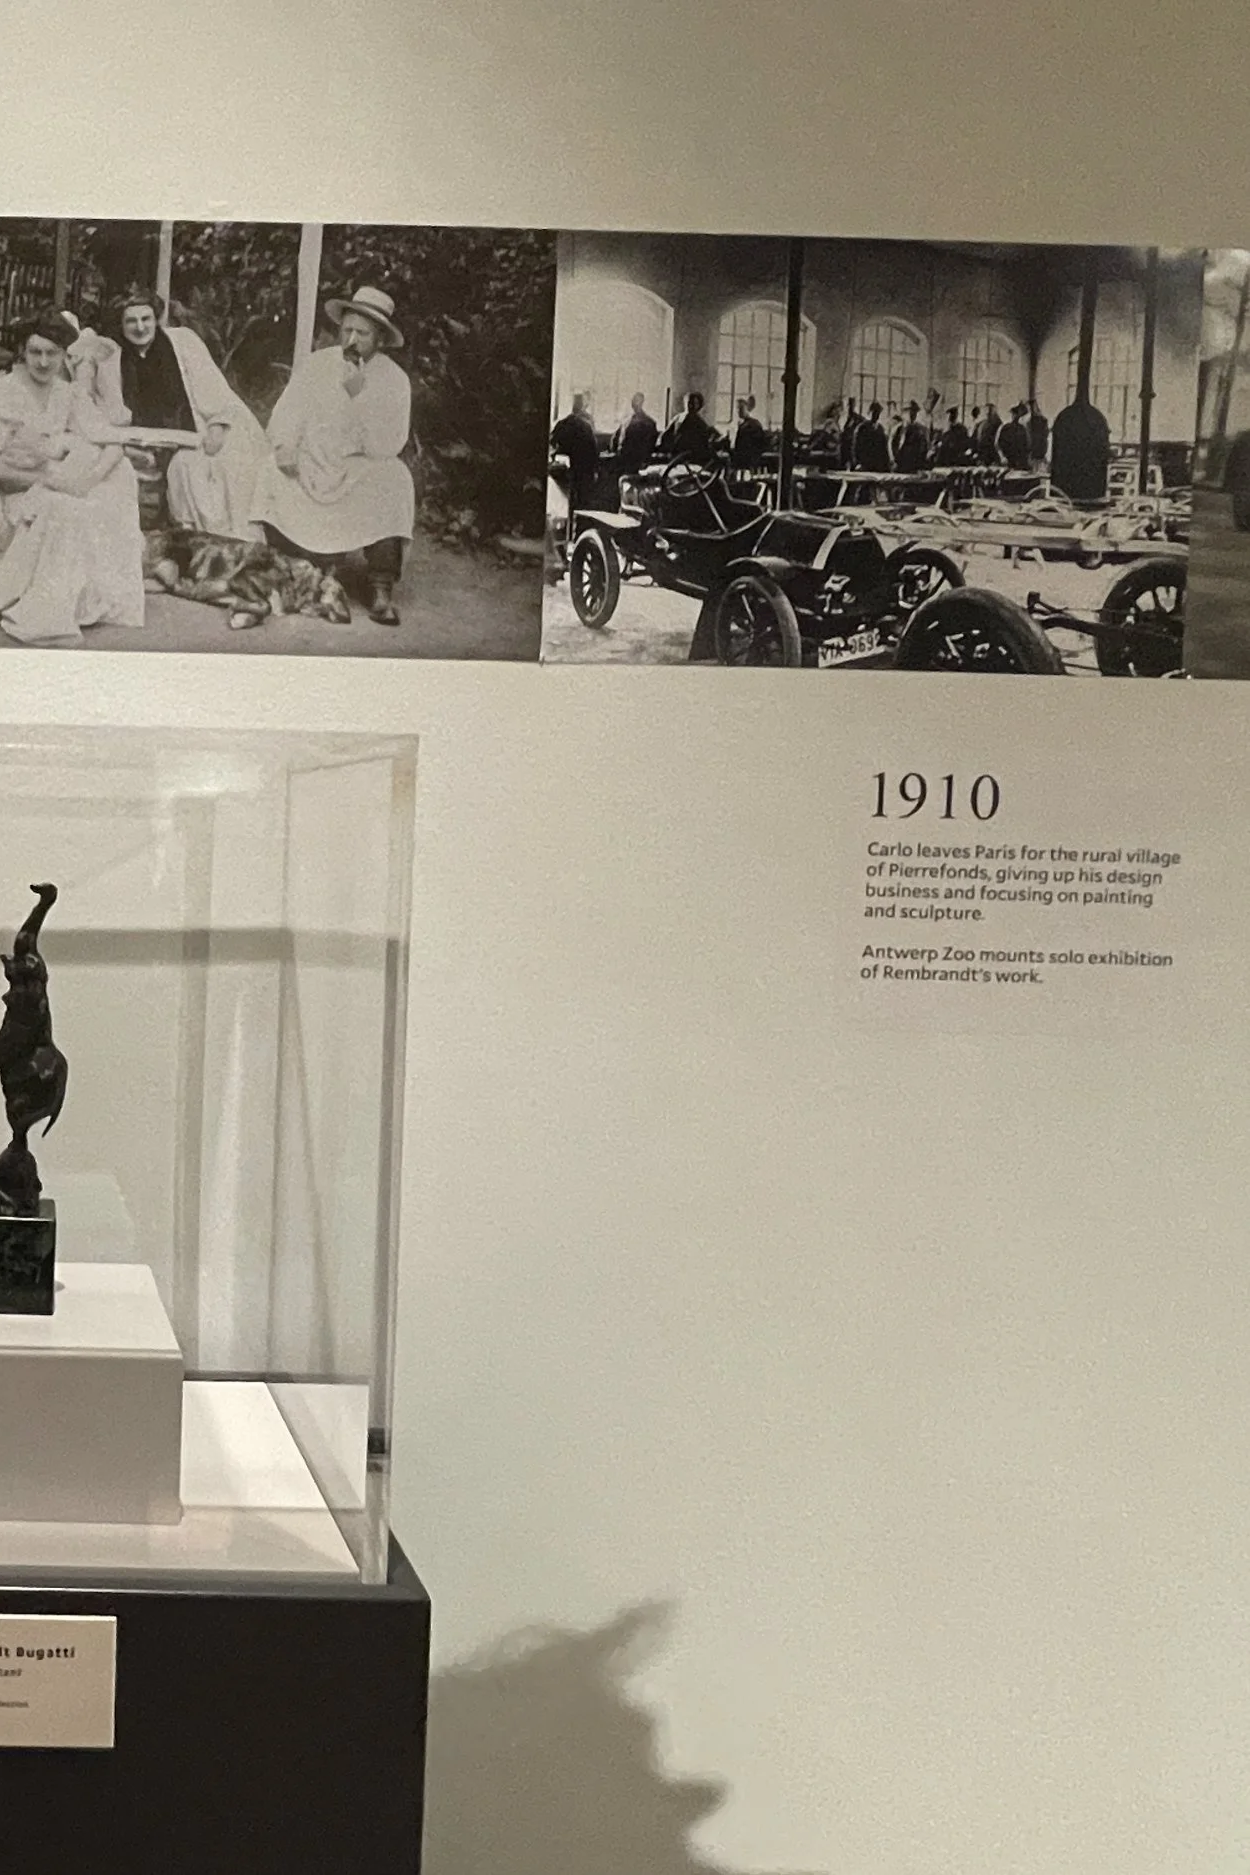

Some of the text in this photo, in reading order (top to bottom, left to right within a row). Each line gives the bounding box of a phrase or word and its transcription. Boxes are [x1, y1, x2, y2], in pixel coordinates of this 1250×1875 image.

[871, 771, 1001, 820] 1910
[867, 841, 1181, 868] Carlo leaves Paris for the rural village
[866, 862, 1163, 887] of Pierrefonds, giving up his design
[865, 883, 1153, 907] business and focusing on painting
[864, 904, 985, 922] and sculpture.
[862, 944, 1174, 967] Antwerp Zoo mounts solo exhibition
[860, 964, 880, 980] of
[995, 968, 1044, 985] work.
[16, 1646, 76, 1661] Bugatti
